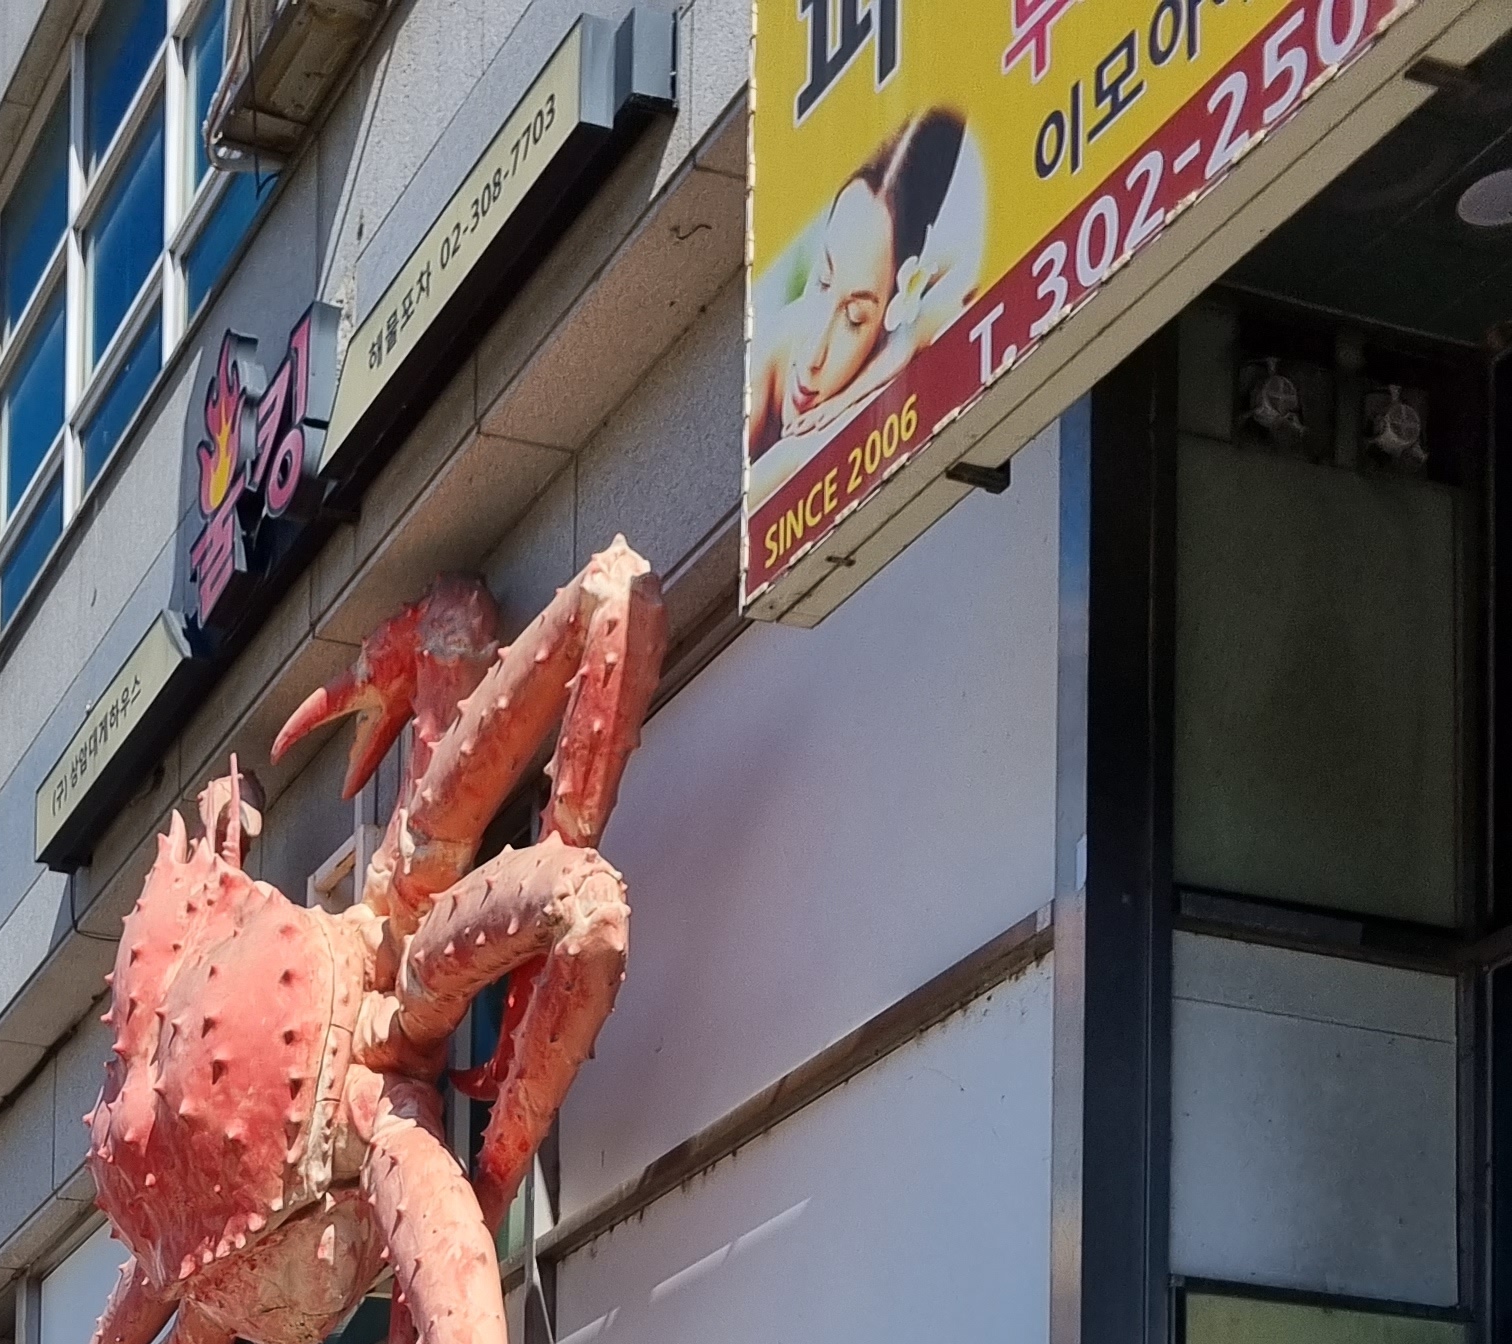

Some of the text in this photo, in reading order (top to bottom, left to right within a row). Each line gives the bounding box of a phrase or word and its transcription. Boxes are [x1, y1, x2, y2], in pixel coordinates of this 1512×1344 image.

[1035, 0, 1230, 179] 이모아
[368, 93, 557, 370] 해물포차 02-308-7703
[764, 393, 918, 569] SINCE 2006
[70, 675, 142, 791] 상암대게하우스
